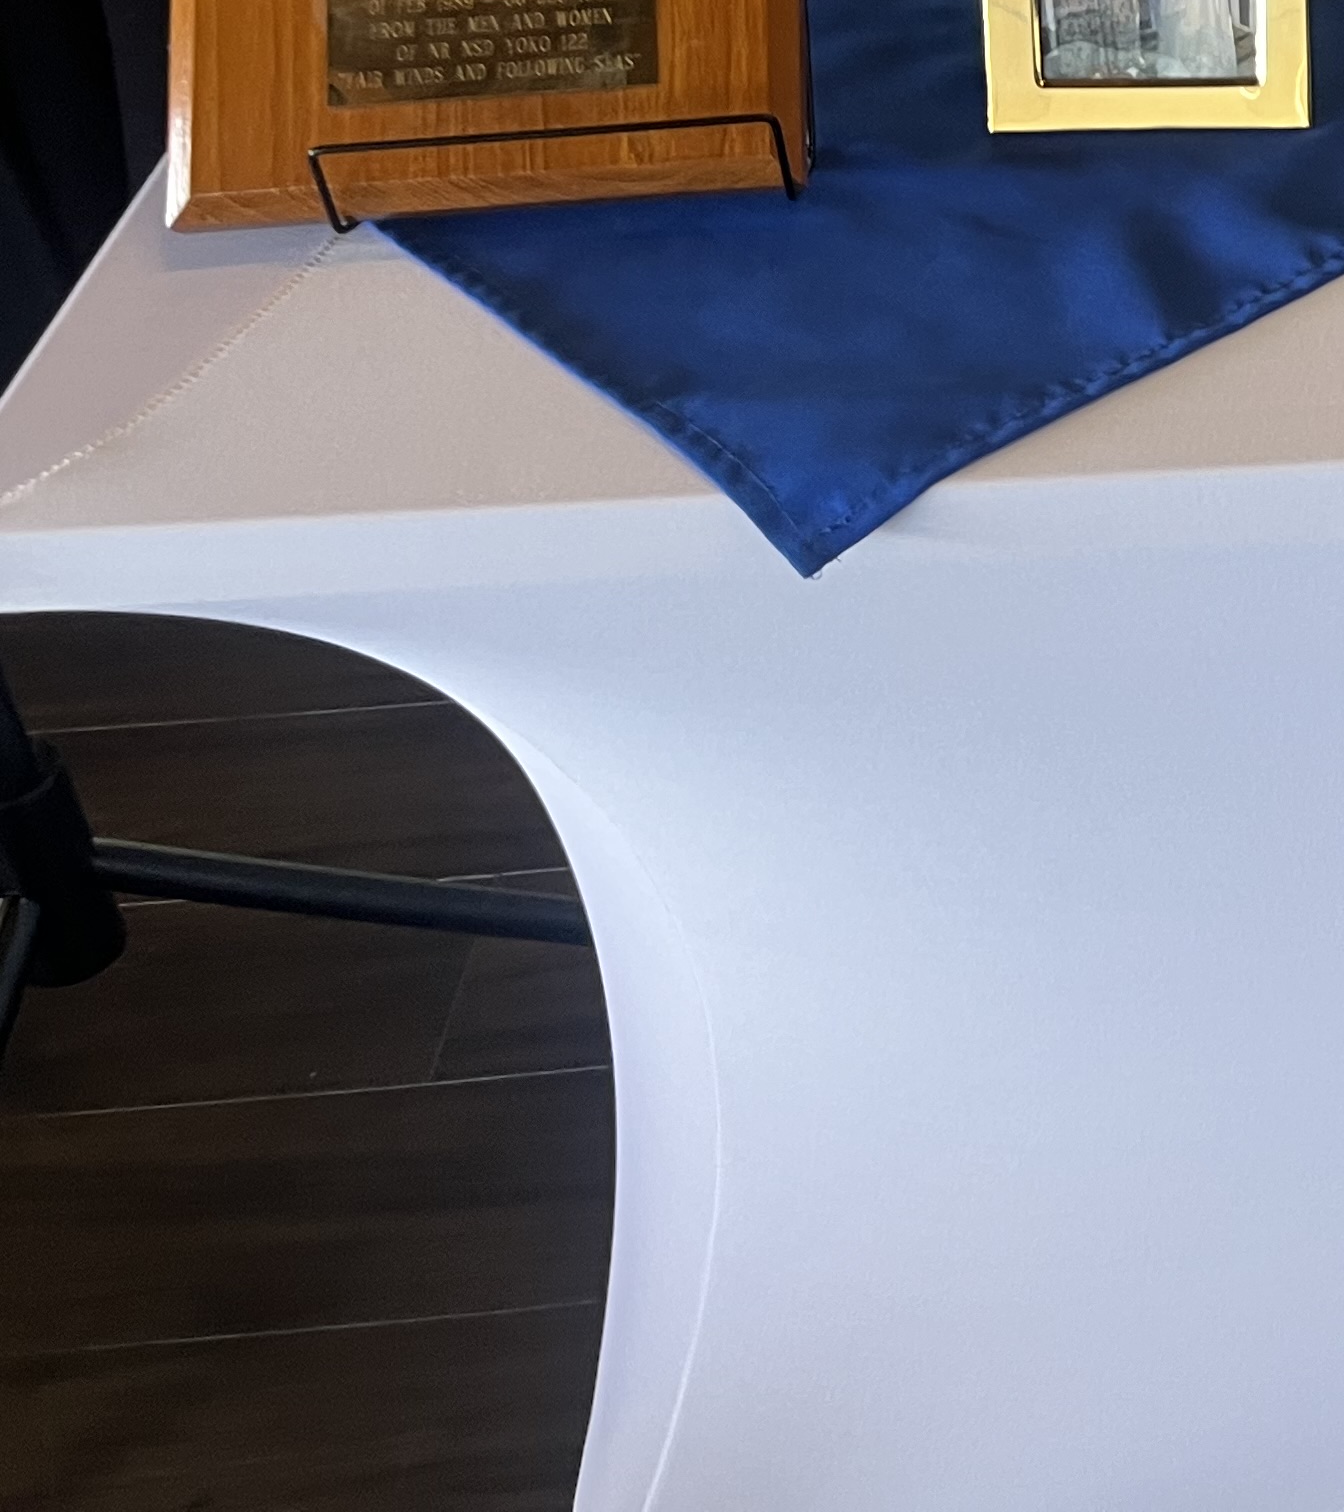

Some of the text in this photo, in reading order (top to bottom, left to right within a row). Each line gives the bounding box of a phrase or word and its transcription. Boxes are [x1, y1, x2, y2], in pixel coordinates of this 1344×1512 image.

[369, 8, 613, 39] FROM THE MEN AND WOMEN
[396, 44, 418, 61] OF
[506, 35, 550, 54] YOKO
[561, 32, 588, 51] 122
[394, 67, 444, 86] WINDS
[456, 63, 486, 82] AND
[497, 56, 585, 79] FOLLOWING
